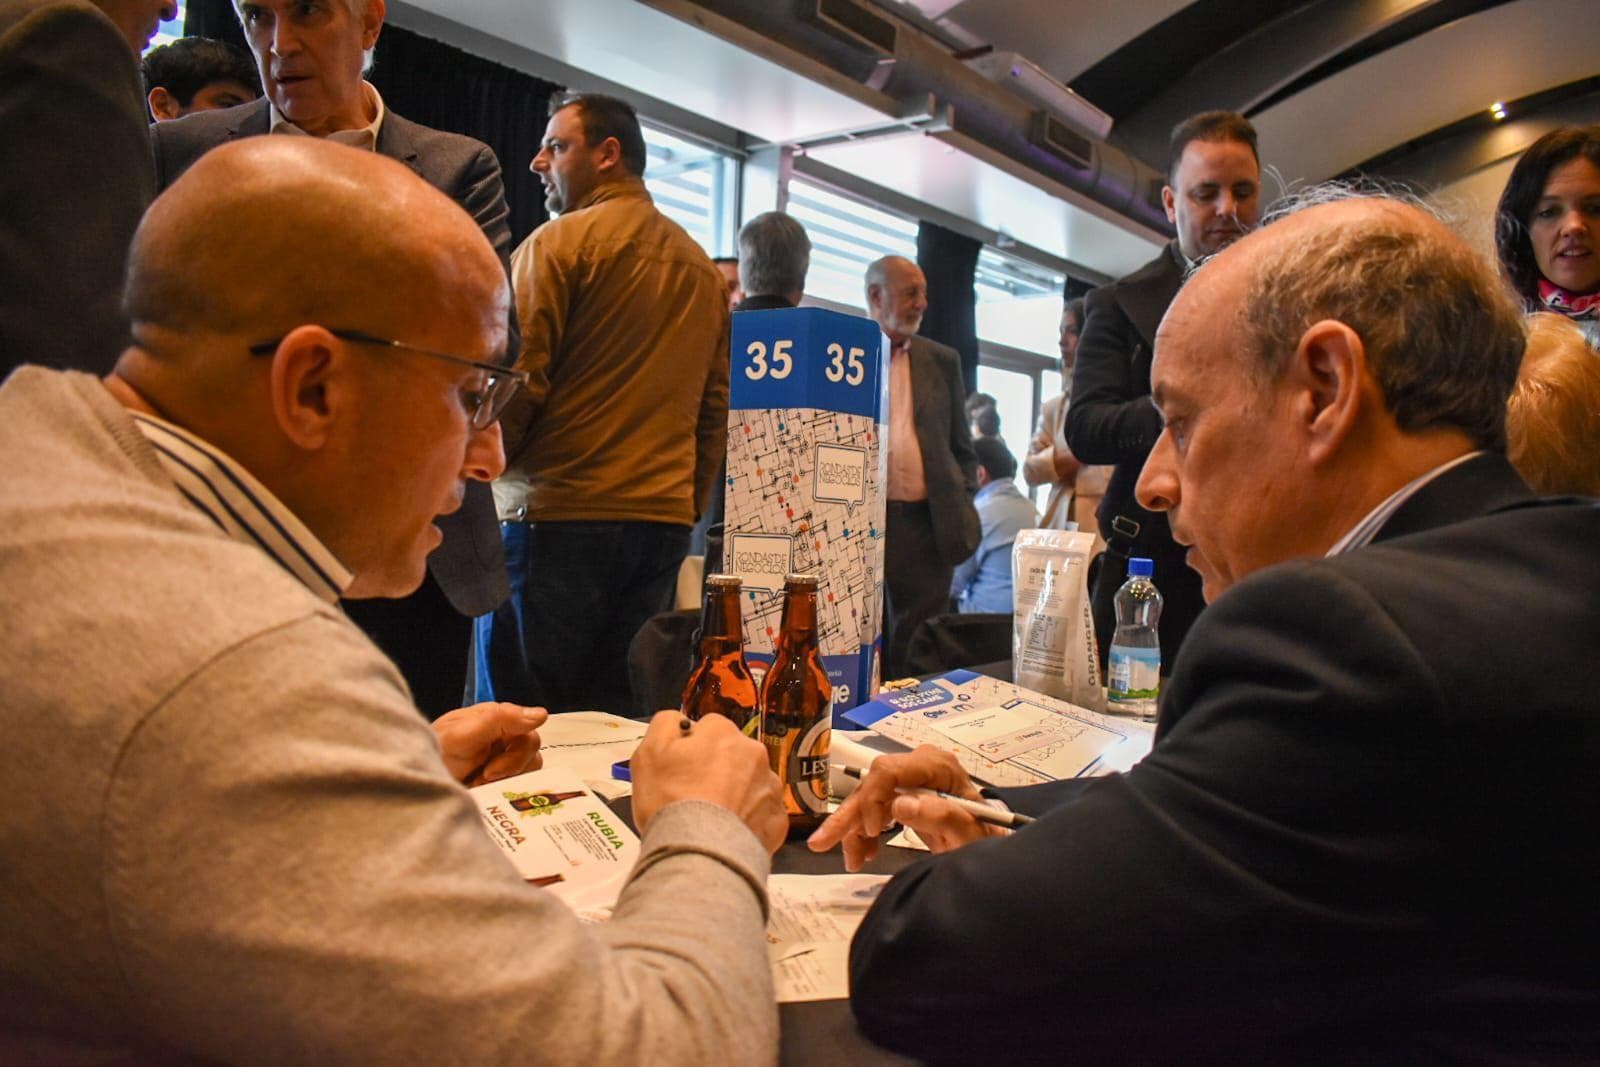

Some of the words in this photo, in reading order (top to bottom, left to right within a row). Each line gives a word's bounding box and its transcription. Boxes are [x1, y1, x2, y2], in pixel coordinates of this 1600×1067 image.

[745, 340, 793, 380] 35
[825, 343, 865, 386] 35
[735, 561, 786, 575] NEGOCIOS
[736, 551, 774, 563] RONDAS
[774, 553, 787, 564] DE
[486, 806, 526, 845] NEGRA
[586, 811, 624, 850] RUBIA
